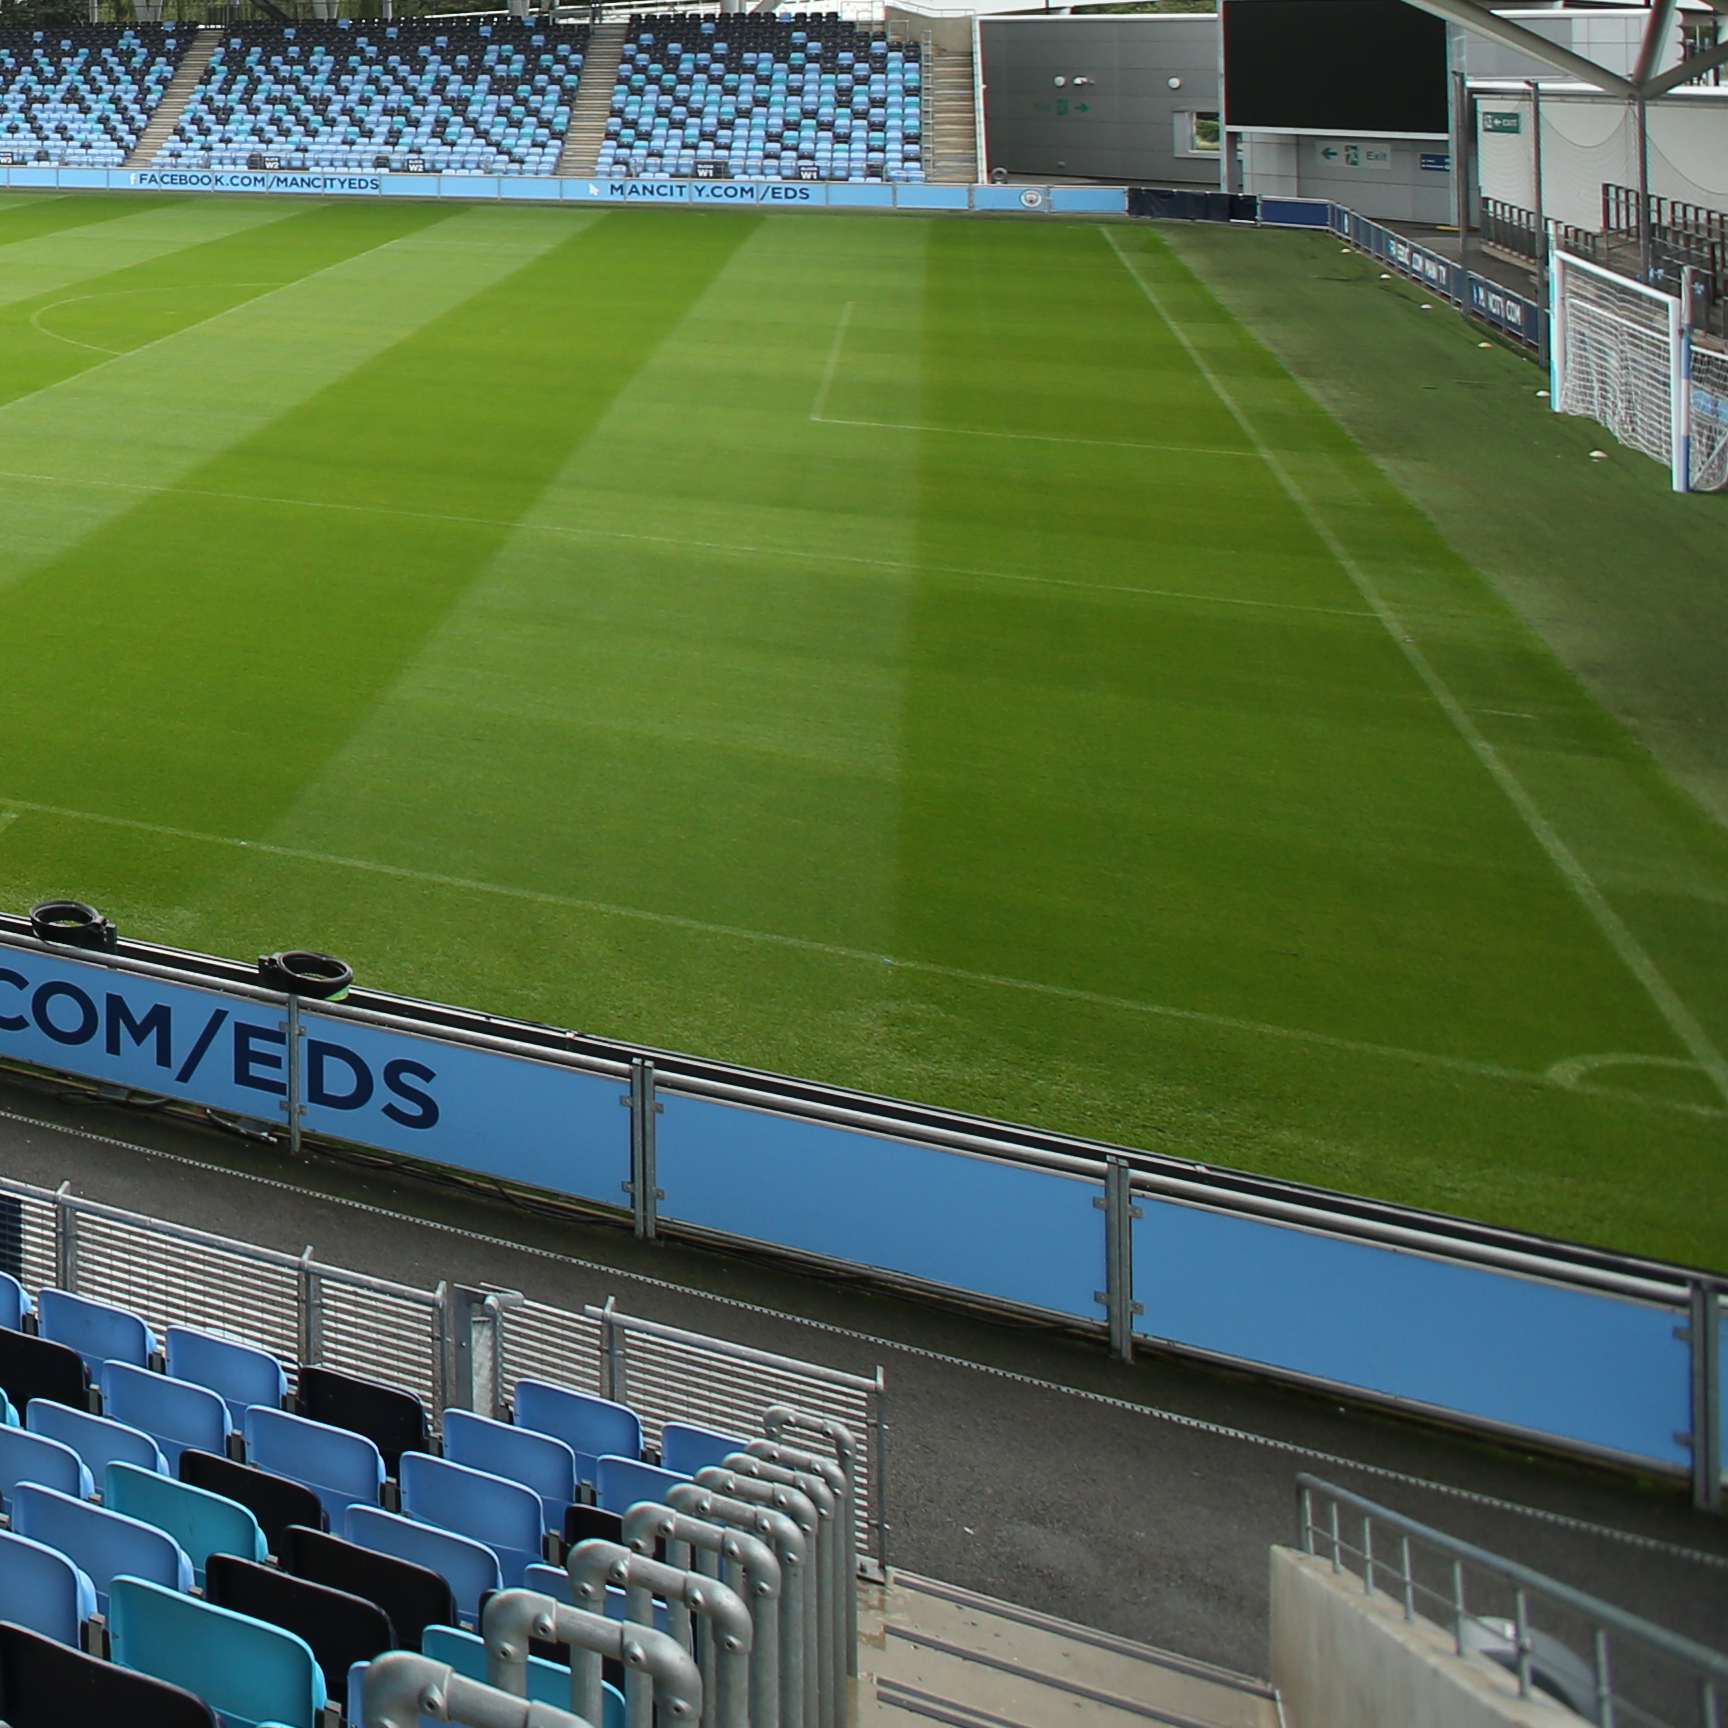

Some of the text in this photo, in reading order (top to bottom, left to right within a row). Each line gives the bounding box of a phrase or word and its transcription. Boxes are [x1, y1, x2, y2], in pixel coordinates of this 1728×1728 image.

[1502, 119, 1518, 127] EXIT
[1366, 151, 1388, 161] Exit
[265, 161, 279, 169] W2
[408, 164, 423, 172] W2
[697, 169, 714, 177] W1
[800, 171, 818, 179] W1
[139, 173, 380, 190] FACEBOOK.COM/MANCITYEDS
[610, 183, 810, 201] MANCITY.COM/EDS
